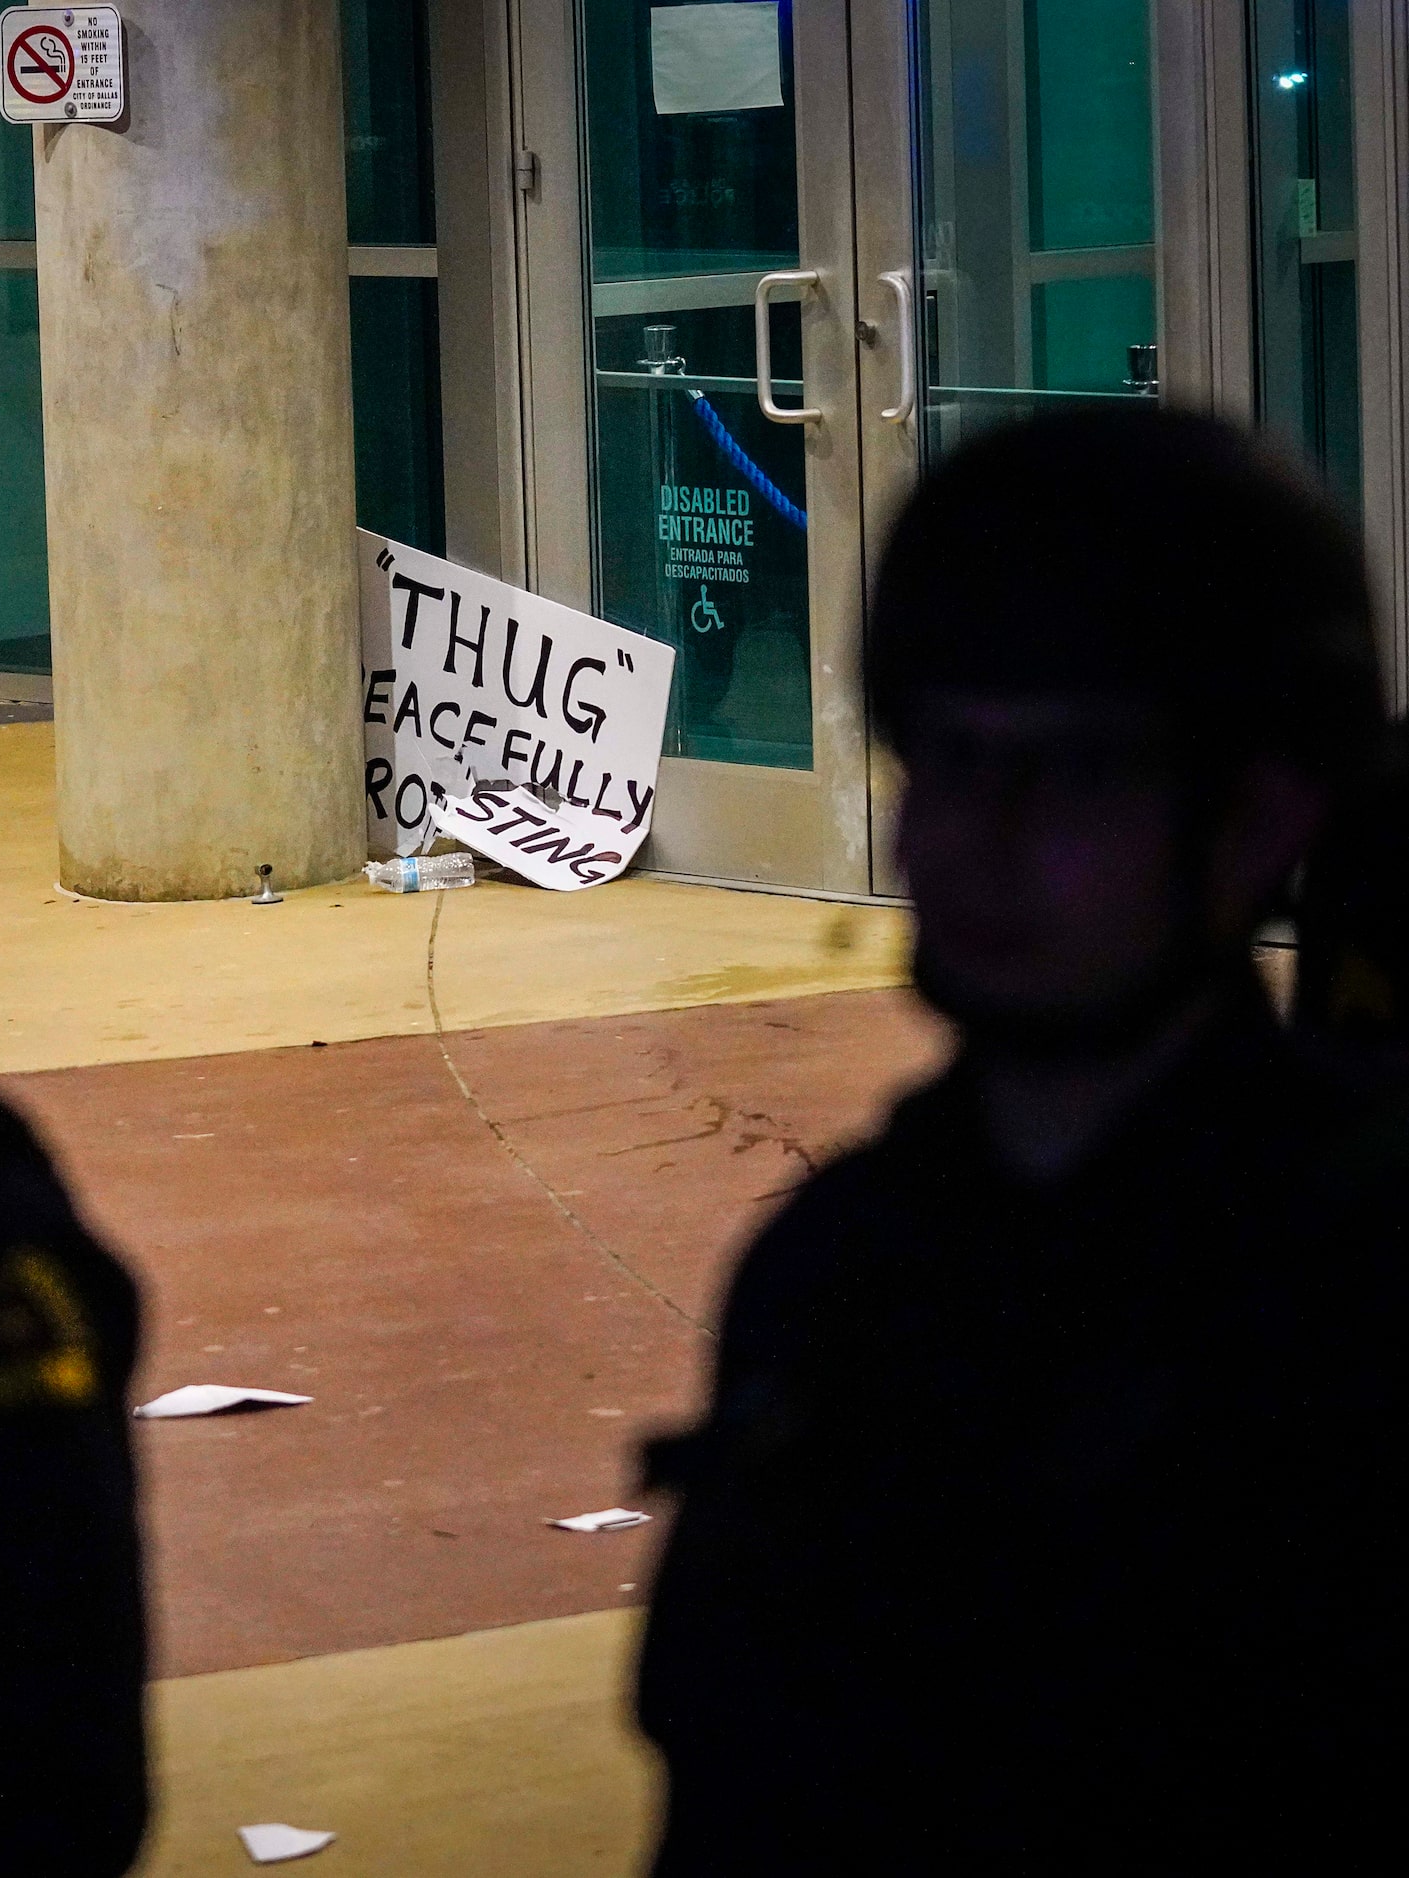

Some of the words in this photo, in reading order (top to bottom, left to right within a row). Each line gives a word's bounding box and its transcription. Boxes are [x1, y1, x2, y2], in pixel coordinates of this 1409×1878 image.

[88, 17, 98, 27] NO
[77, 29, 110, 39] SMOKING
[81, 41, 107, 51] WITHIN
[81, 55, 88, 64] 15
[91, 54, 107, 64] FEET
[90, 66, 99, 76] OF
[77, 79, 113, 89] ENTRANCE
[73, 92, 86, 100] CITY
[88, 92, 95, 100] OF
[97, 91, 118, 100] DALLAS
[80, 102, 111, 110] ORDINANCE
[661, 485, 750, 516] DISABLED
[658, 514, 754, 547] ENTRANCE
[670, 547, 715, 564] ENTRADA
[717, 550, 743, 566] PARA
[665, 564, 749, 584] DESCAPACITADOS
[375, 547, 634, 744] "THUG"
[362, 661, 655, 834] EACEFULLY
